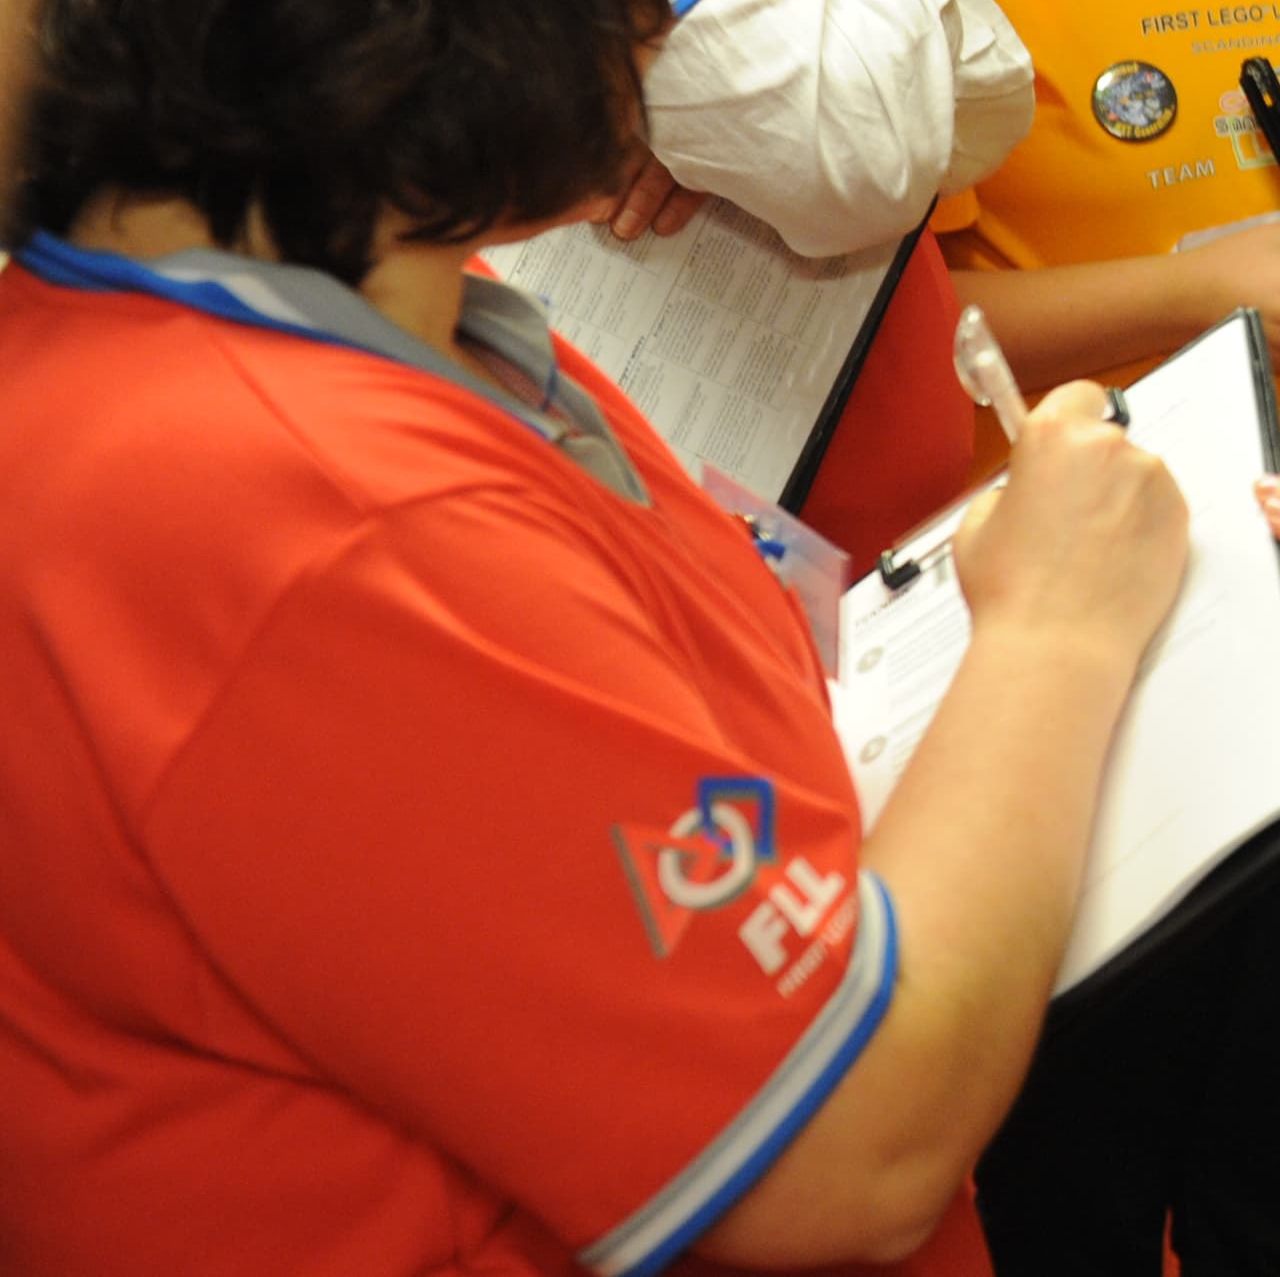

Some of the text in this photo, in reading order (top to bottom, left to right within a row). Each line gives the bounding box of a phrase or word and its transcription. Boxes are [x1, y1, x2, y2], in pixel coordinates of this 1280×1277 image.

[1141, 12, 1201, 35] FIRST
[1148, 159, 1215, 189] TEAM
[738, 856, 846, 977] FLL
